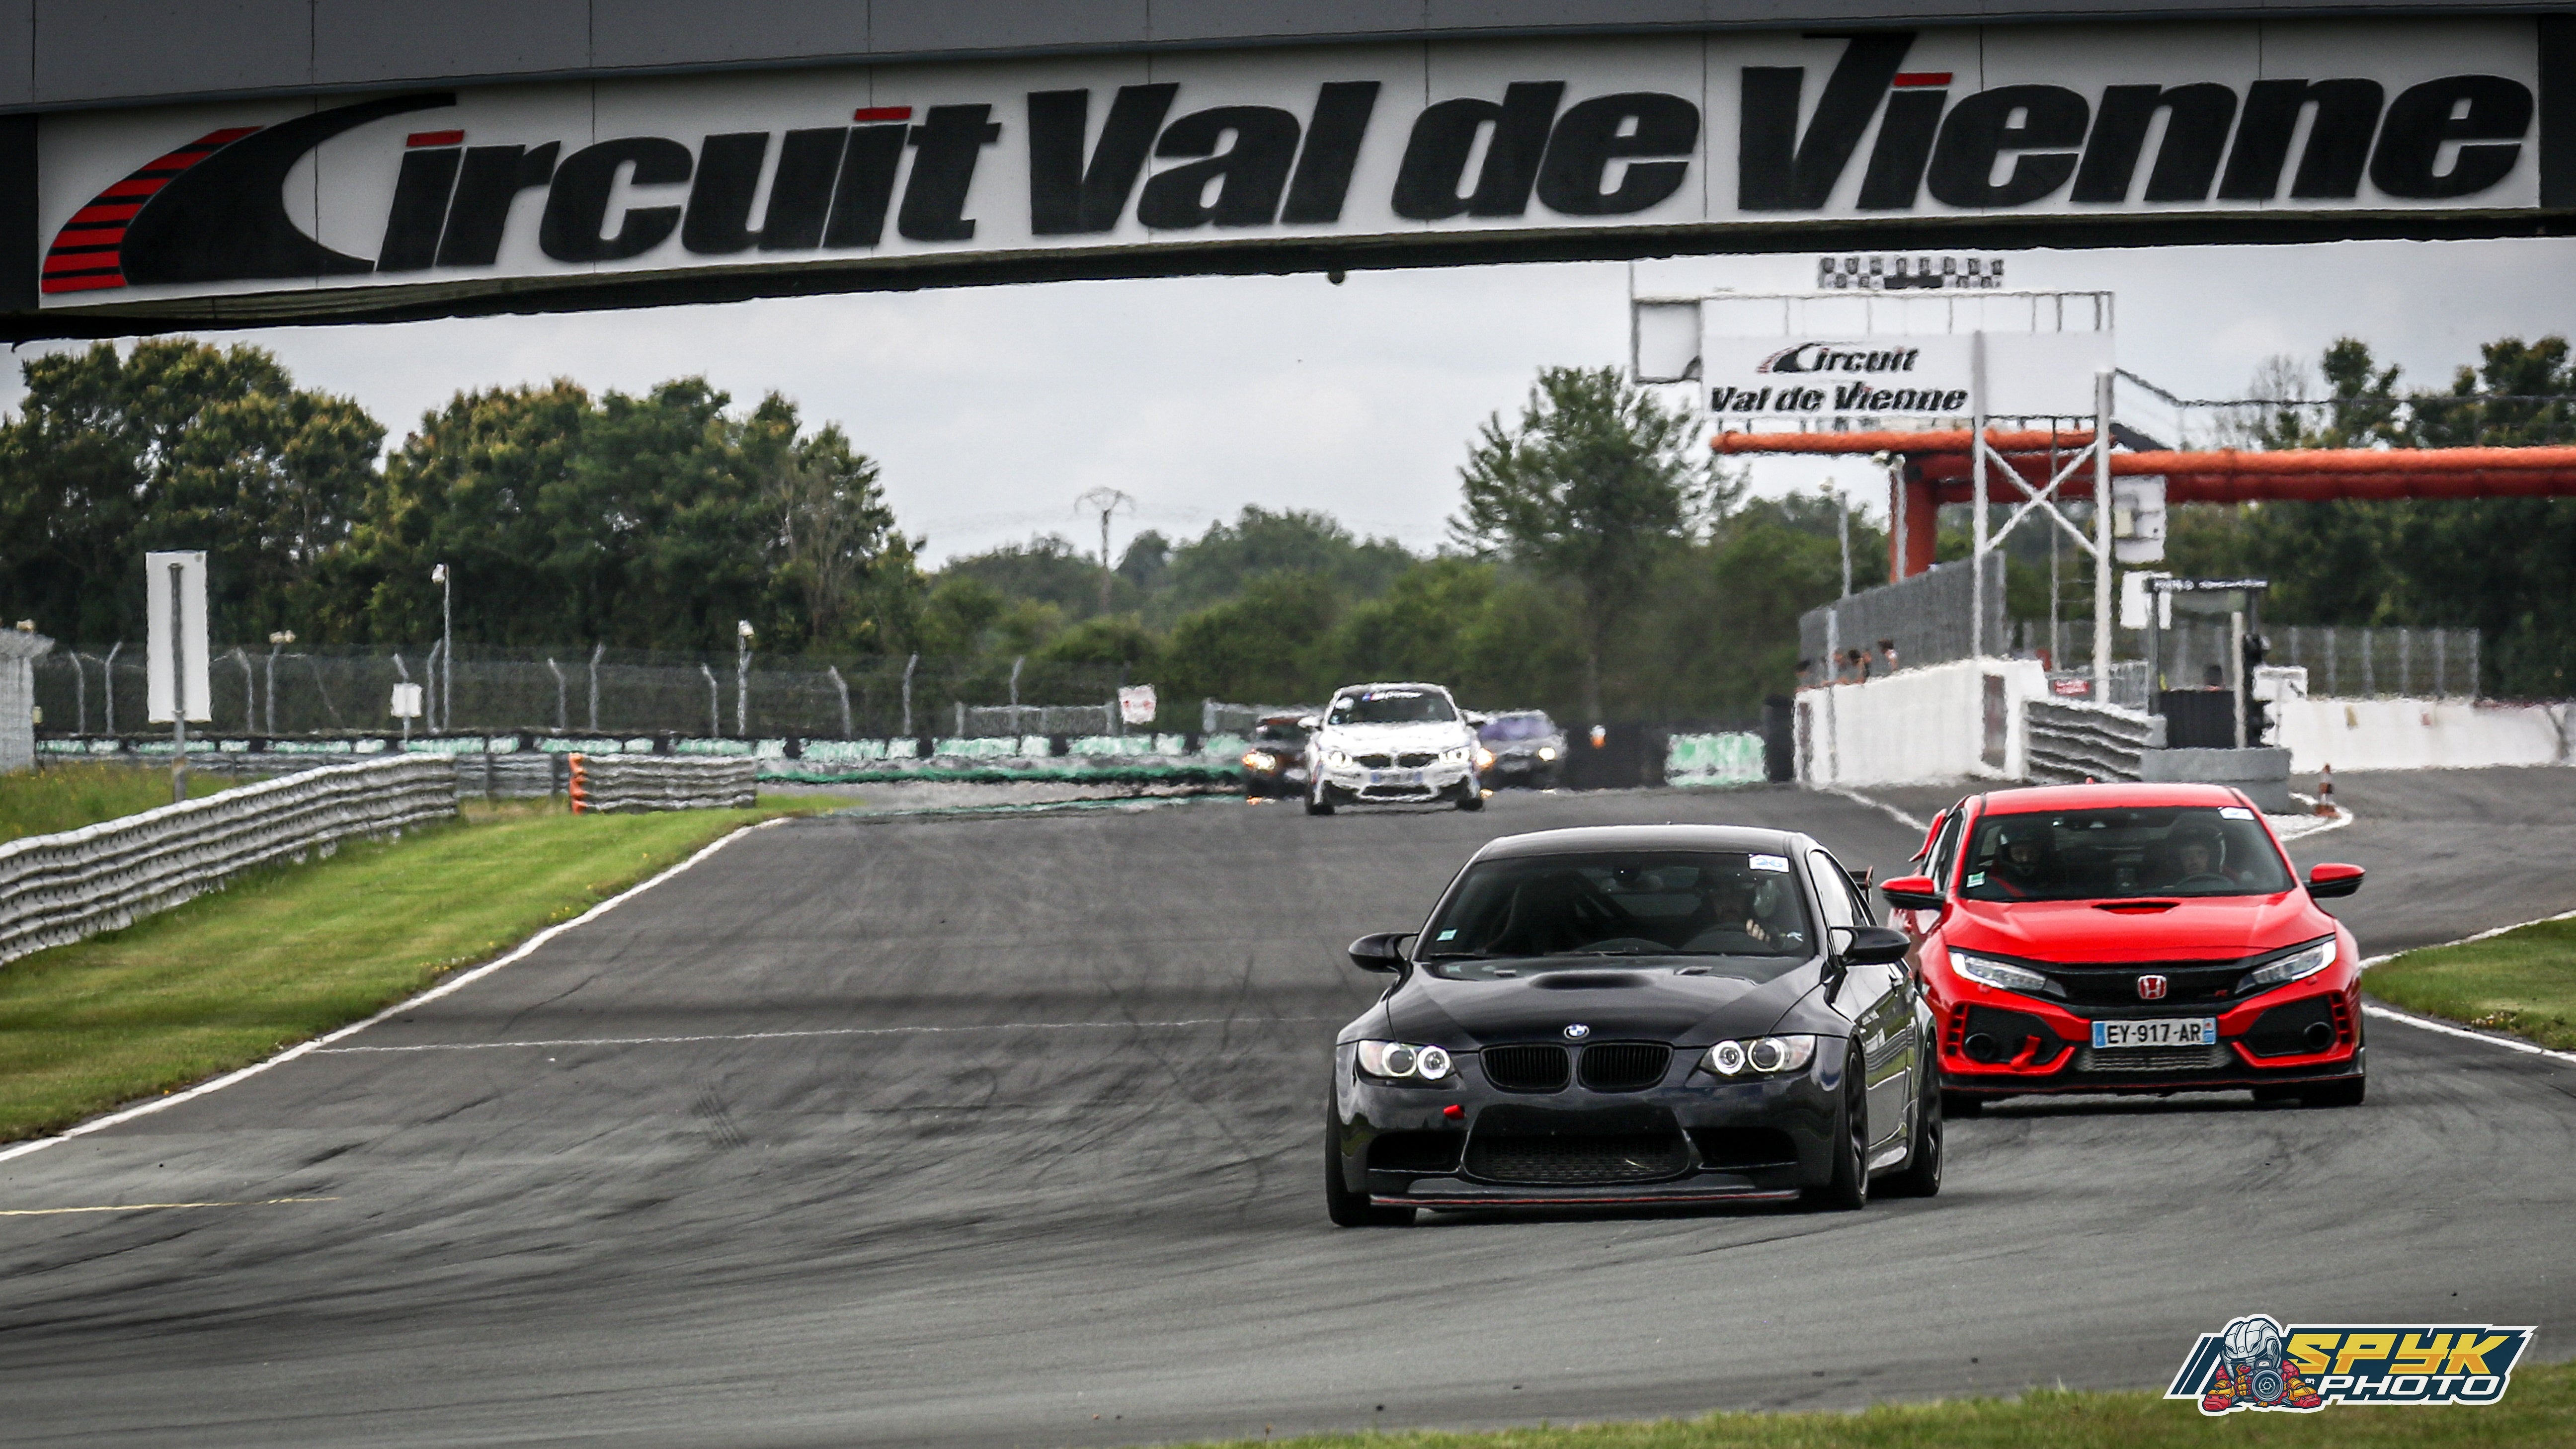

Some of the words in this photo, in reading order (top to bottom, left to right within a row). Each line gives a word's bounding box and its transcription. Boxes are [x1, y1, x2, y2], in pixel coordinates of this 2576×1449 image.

[41, 92, 1000, 292] Circuit
[1028, 81, 1381, 235] Val
[1391, 81, 1700, 221] de
[1738, 32, 2533, 211] Vienne
[1756, 342, 1919, 373] Circuit
[1710, 386, 1773, 412] Val
[1774, 385, 1827, 412] de
[1834, 381, 1969, 411] Vienne
[2107, 1023, 2201, 1044] EY-917-AR
